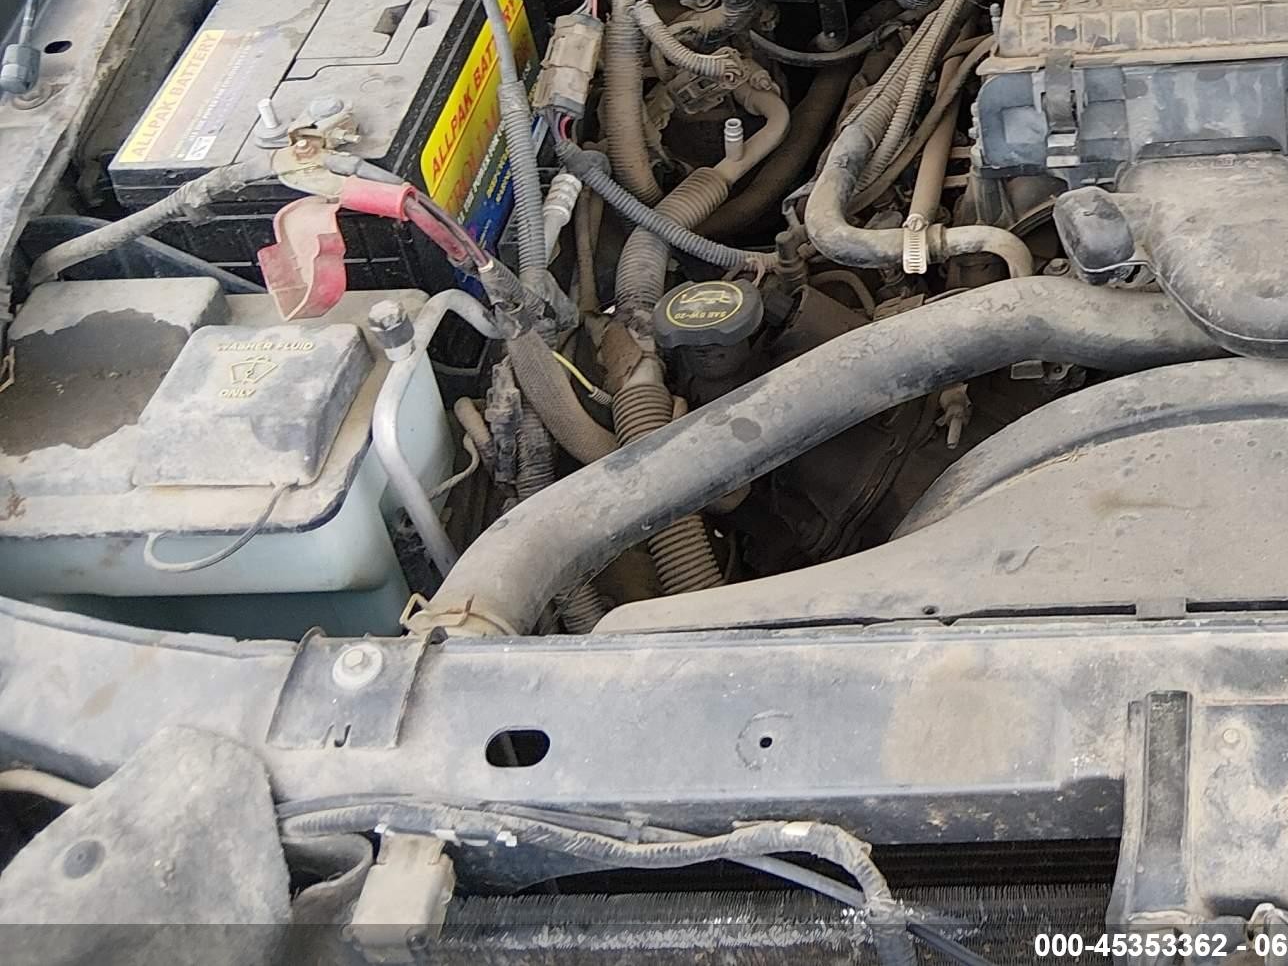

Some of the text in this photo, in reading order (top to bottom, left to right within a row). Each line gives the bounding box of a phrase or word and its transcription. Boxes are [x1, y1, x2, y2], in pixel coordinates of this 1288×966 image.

[132, 100, 177, 156] ALLPAK
[171, 33, 217, 95] BATTERY
[432, 94, 474, 182] ALLPAK
[279, 341, 315, 351] FLUID
[219, 388, 257, 399] ONLY
